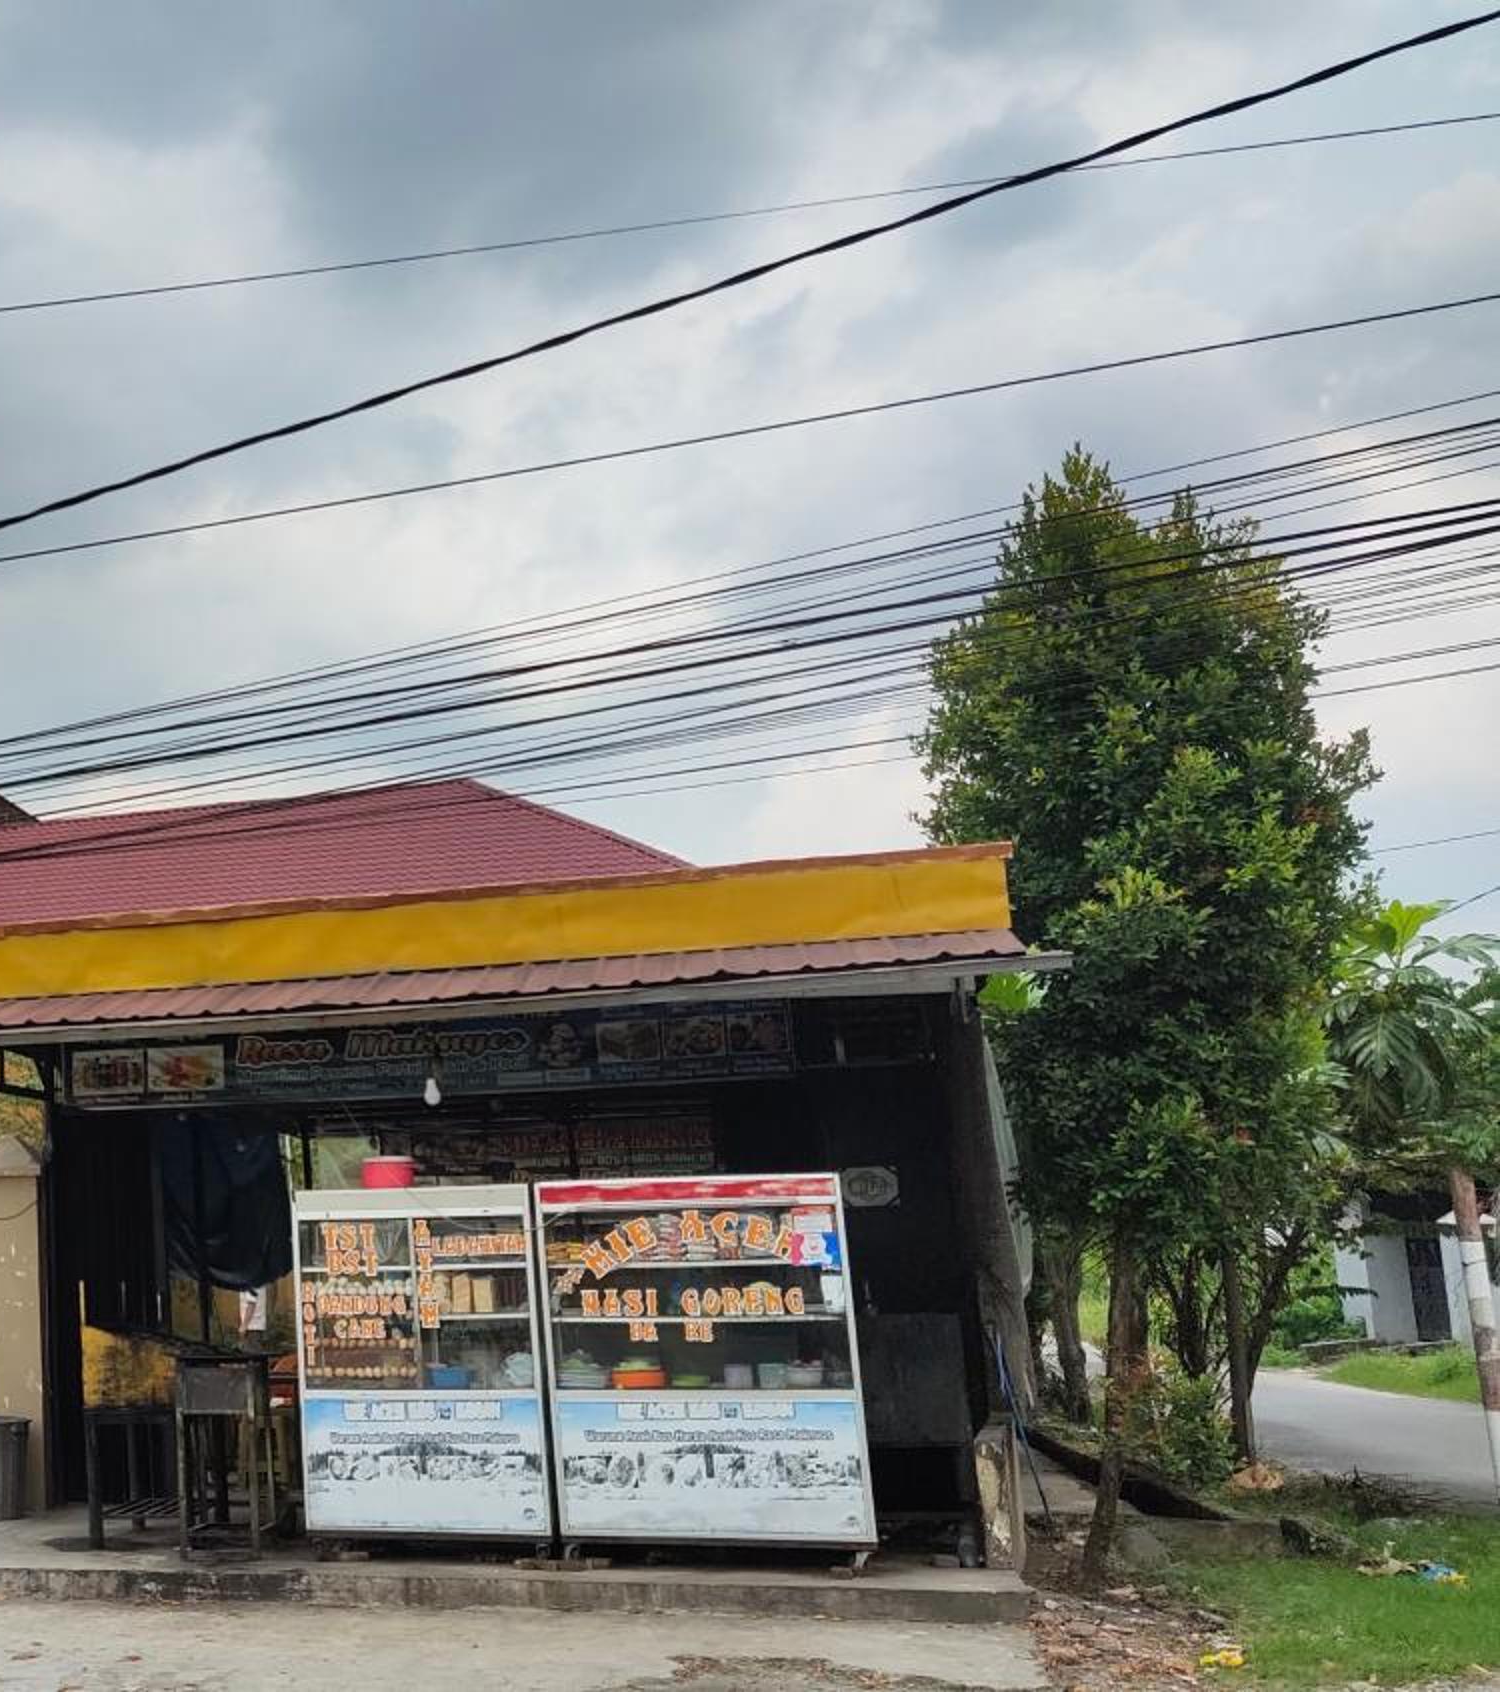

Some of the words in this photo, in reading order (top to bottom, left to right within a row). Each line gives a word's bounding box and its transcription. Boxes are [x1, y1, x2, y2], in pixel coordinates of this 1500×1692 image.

[580, 1216, 658, 1279] MIE
[326, 1249, 378, 1277] BST
[581, 1288, 658, 1317] NASI
[681, 1286, 805, 1316] GORENG
[333, 1318, 387, 1339] CANE
